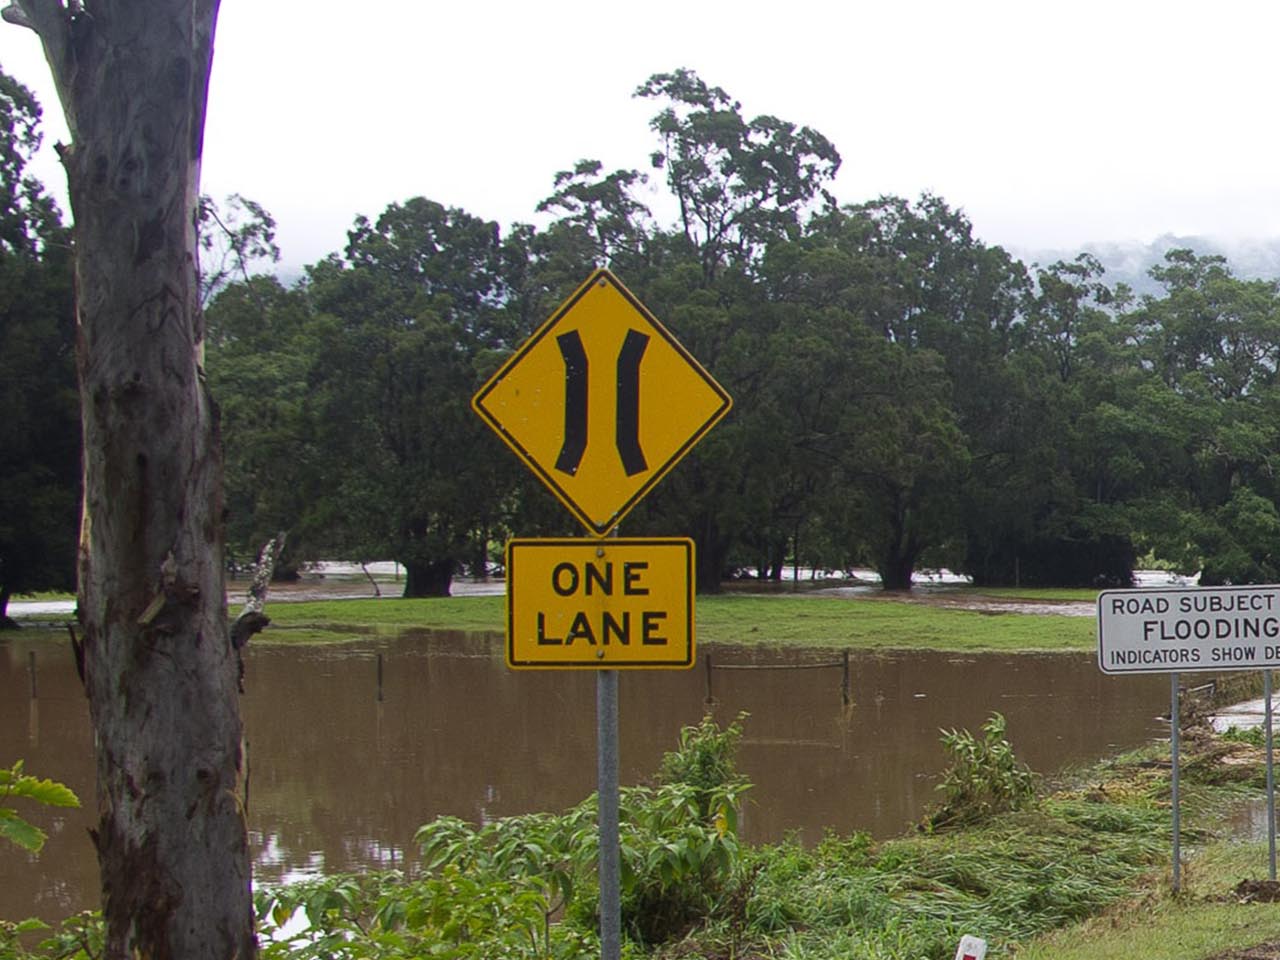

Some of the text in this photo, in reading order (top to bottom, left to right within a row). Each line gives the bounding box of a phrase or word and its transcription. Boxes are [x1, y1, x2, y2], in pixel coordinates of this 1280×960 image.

[551, 562, 650, 597] ONE
[1111, 598, 1170, 615] ROAD
[1179, 594, 1276, 613] SUBJECT
[537, 611, 668, 646] LANE
[1143, 617, 1280, 642] FLOODING
[1111, 649, 1201, 665] INDICATORS
[1211, 646, 1256, 662] SHOW
